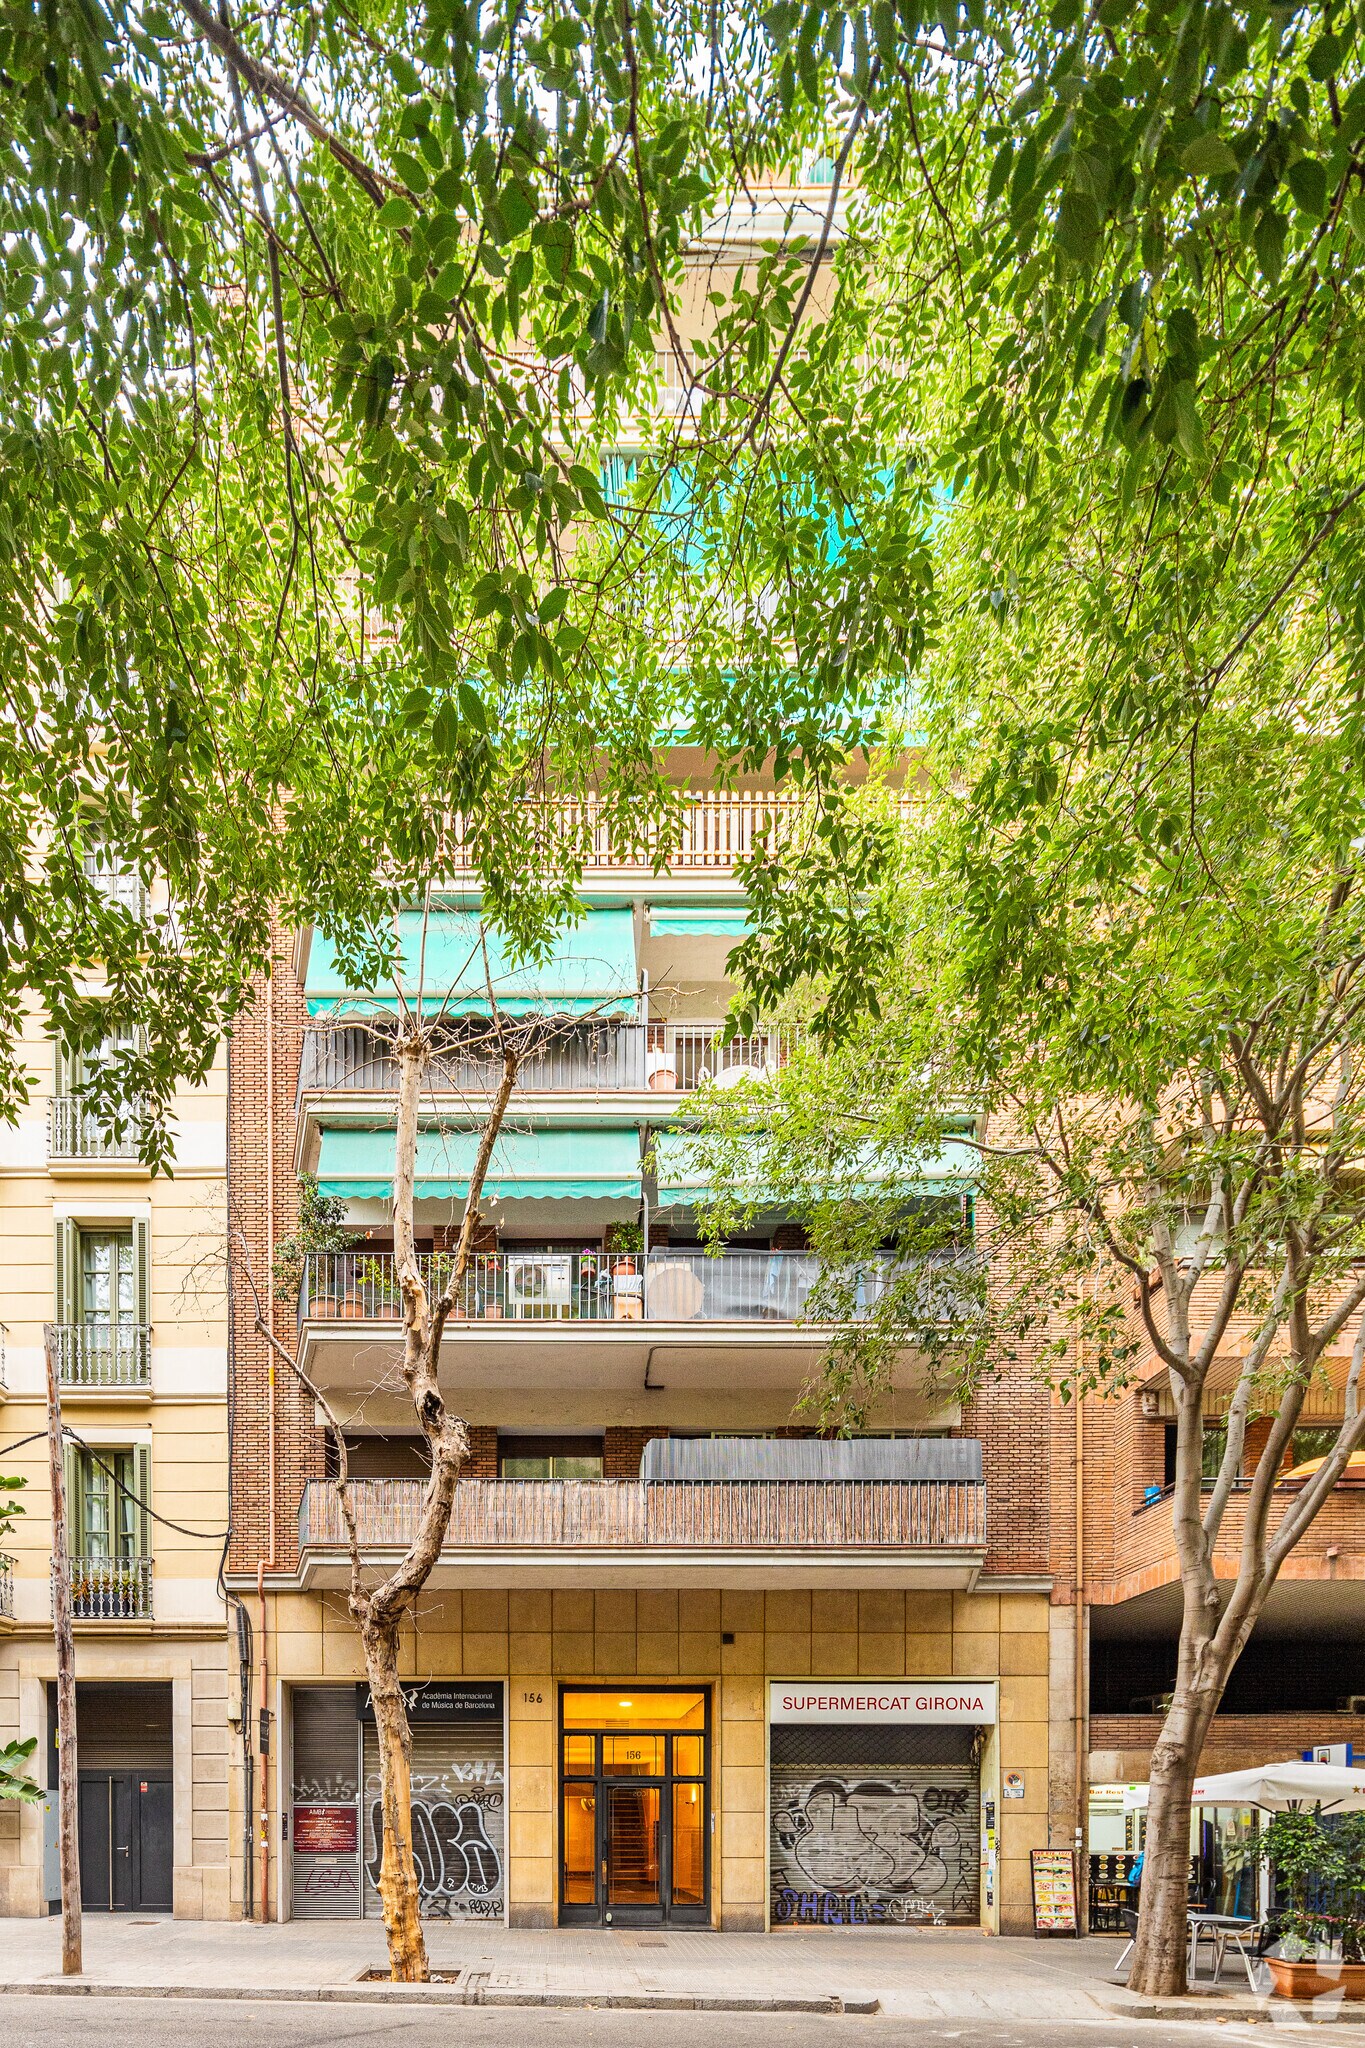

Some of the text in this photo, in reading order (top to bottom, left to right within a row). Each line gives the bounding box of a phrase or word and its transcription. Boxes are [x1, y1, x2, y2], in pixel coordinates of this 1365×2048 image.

[422, 1692, 493, 1700] Acadèmia Internacional
[523, 1692, 543, 1704] 156
[431, 1700, 454, 1709] Música
[782, 1696, 984, 1711] SUPERMERCAT GIRONA
[626, 1750, 642, 1760] 156
